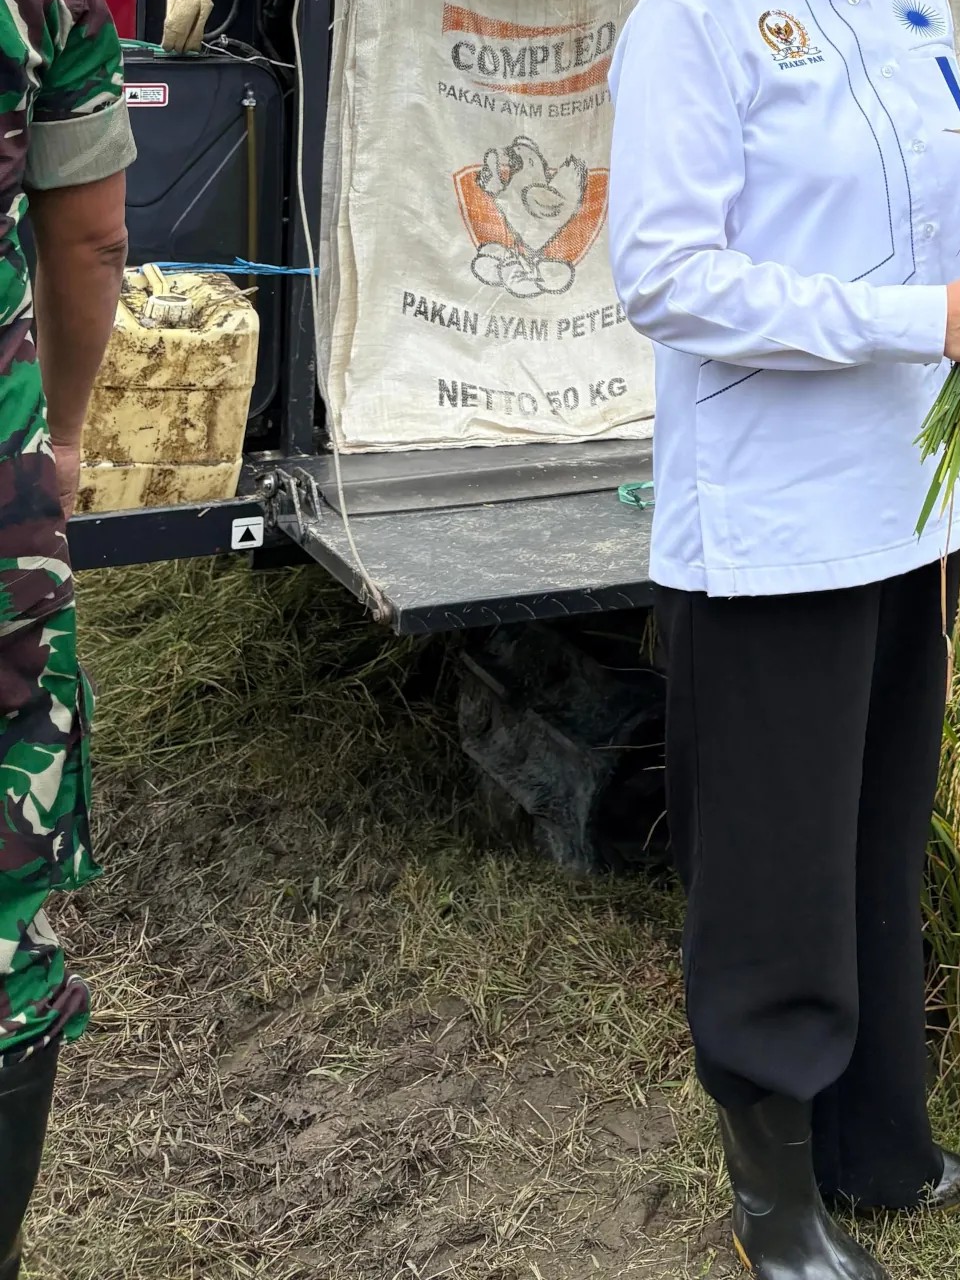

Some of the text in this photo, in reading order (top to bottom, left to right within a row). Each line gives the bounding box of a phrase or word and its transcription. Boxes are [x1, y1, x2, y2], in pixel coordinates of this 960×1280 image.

[778, 55, 825, 70] FRAKSI PAN
[438, 81, 496, 112] PAKAN
[500, 100, 543, 119] AYAM
[402, 290, 479, 336] PAKAN
[484, 314, 549, 342] AYAM
[438, 377, 628, 417] NETTO 50 KG
